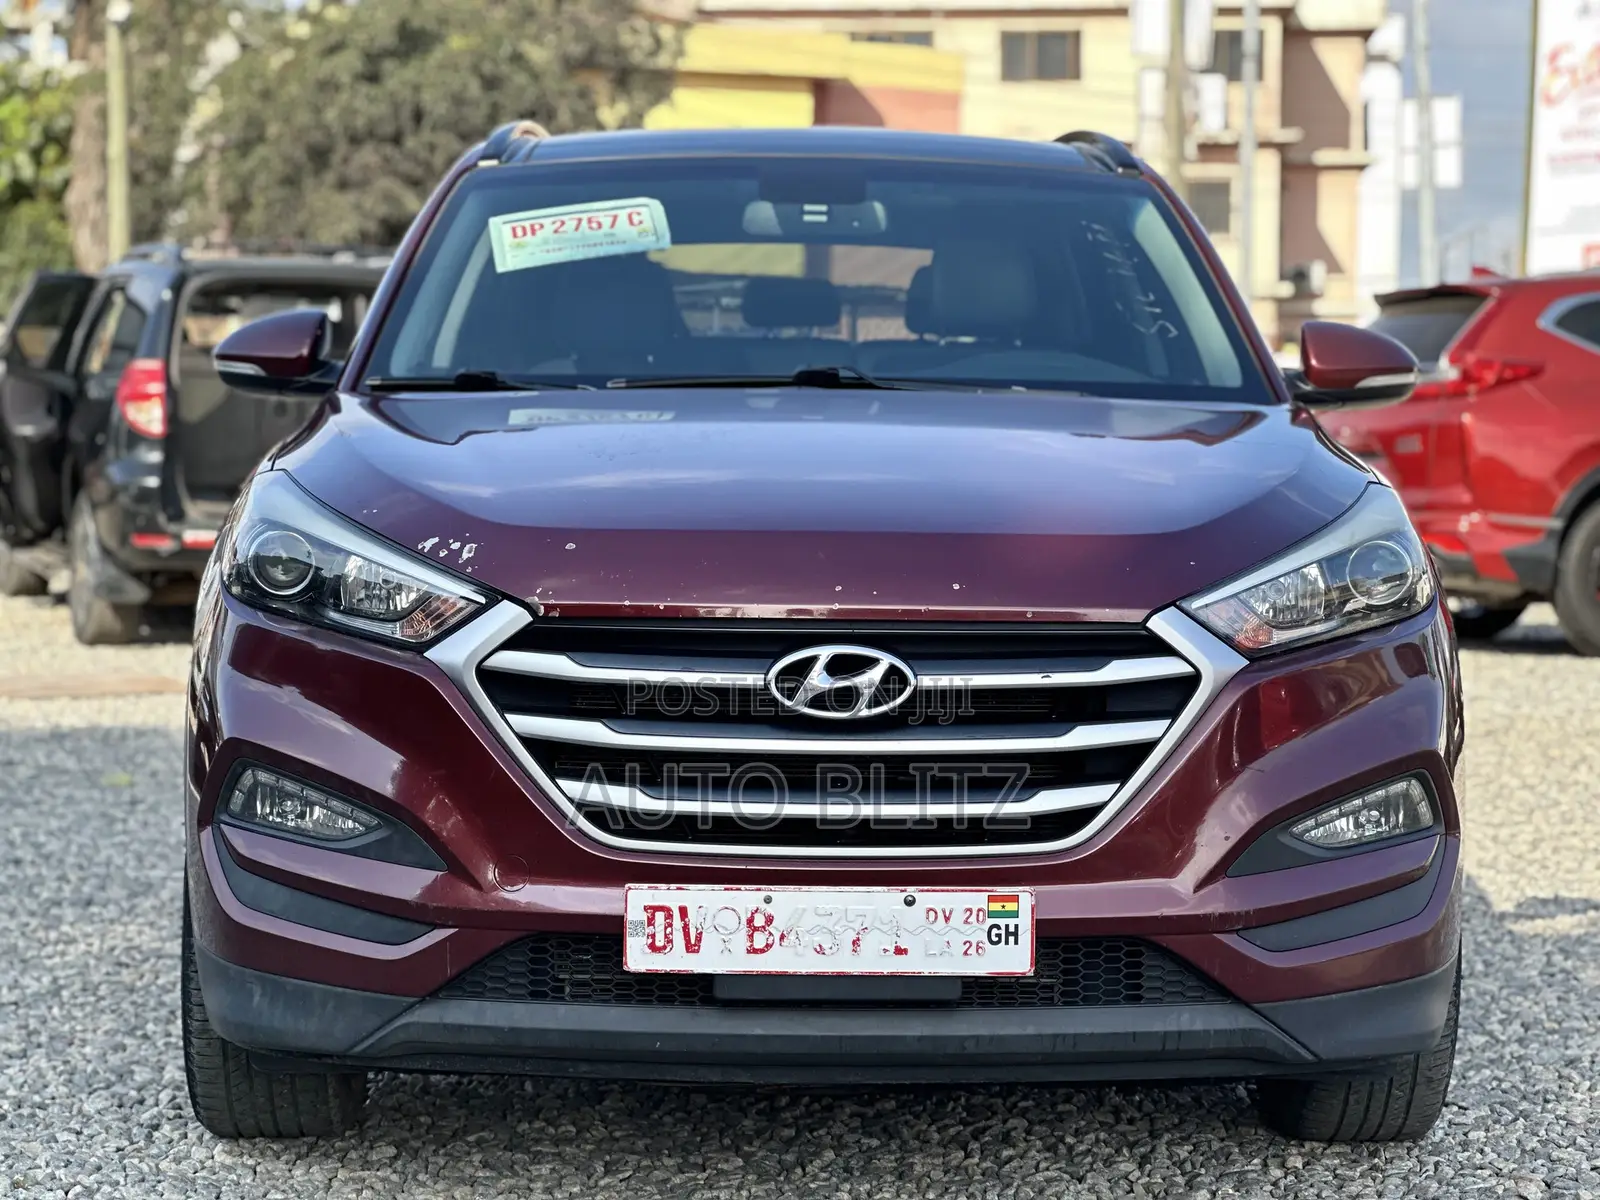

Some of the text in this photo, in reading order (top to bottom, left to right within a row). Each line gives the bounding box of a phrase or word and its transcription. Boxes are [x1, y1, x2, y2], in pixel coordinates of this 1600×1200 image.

[510, 221, 545, 240] DP
[627, 211, 644, 228] C
[924, 907, 986, 925] DV 20
[643, 904, 709, 956] DV
[986, 923, 1019, 946] GH
[962, 939, 987, 957] 26
